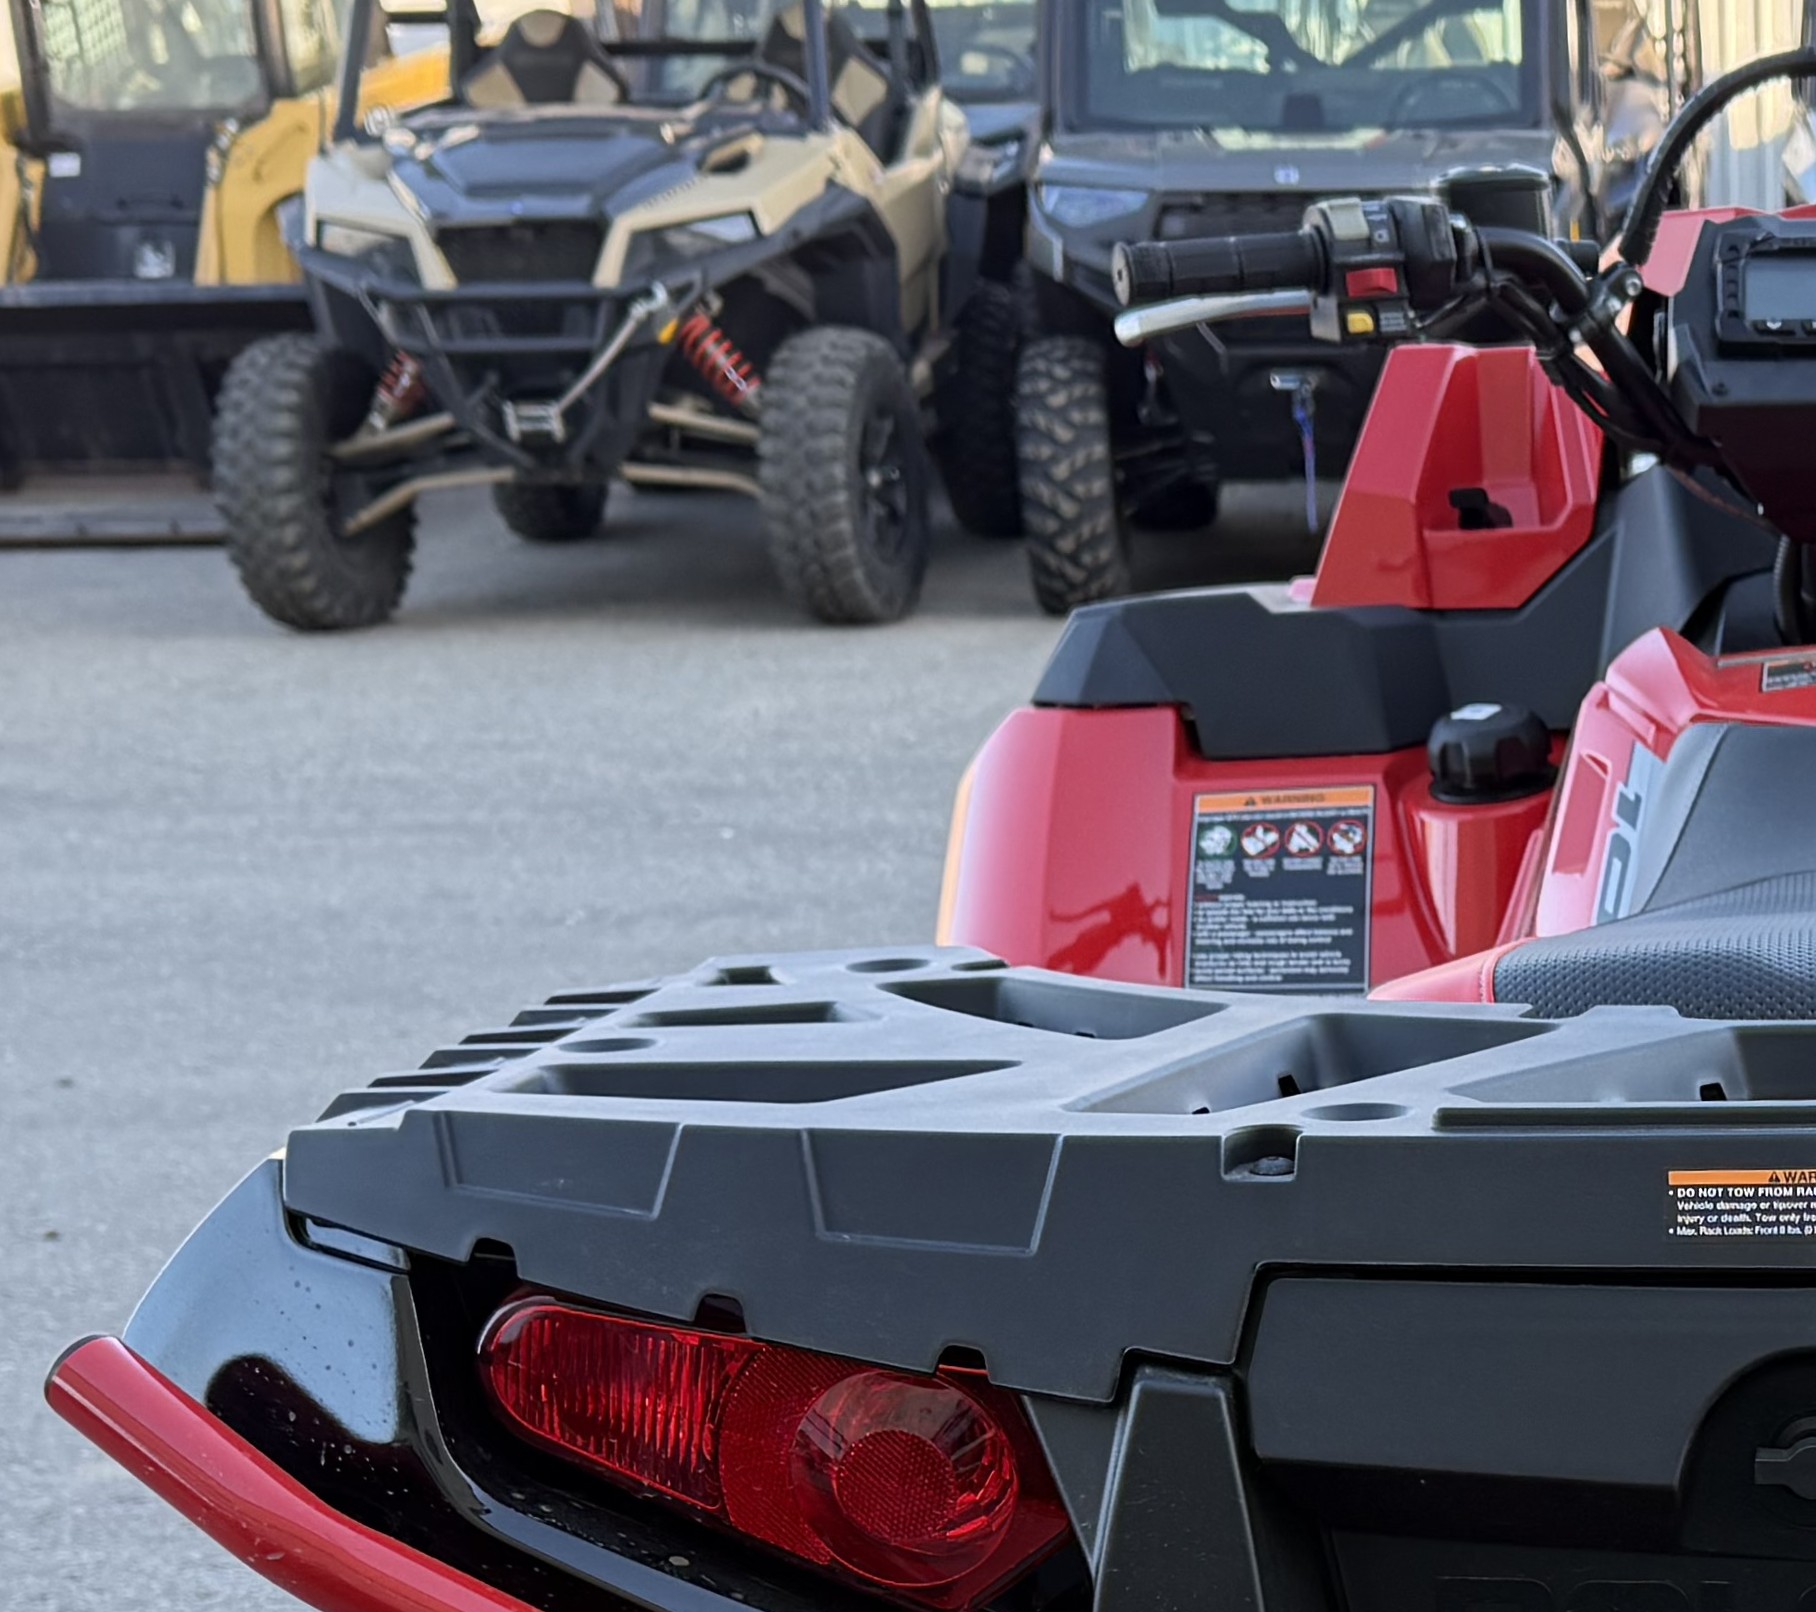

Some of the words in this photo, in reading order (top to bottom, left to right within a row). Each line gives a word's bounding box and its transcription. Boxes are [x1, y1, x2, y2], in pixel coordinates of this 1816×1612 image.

[1677, 1187, 1695, 1198] DO
[1698, 1187, 1723, 1198] NOT
[1727, 1187, 1754, 1198] TOW
[1758, 1187, 1793, 1198] FROM
[1677, 1201, 1714, 1211] Vehicle
[1716, 1201, 1757, 1212] damage
[1759, 1202, 1770, 1210] or
[1707, 1215, 1718, 1223] or
[1720, 1213, 1752, 1223] death.
[1755, 1212, 1777, 1222] Tow
[1779, 1212, 1801, 1225] only
